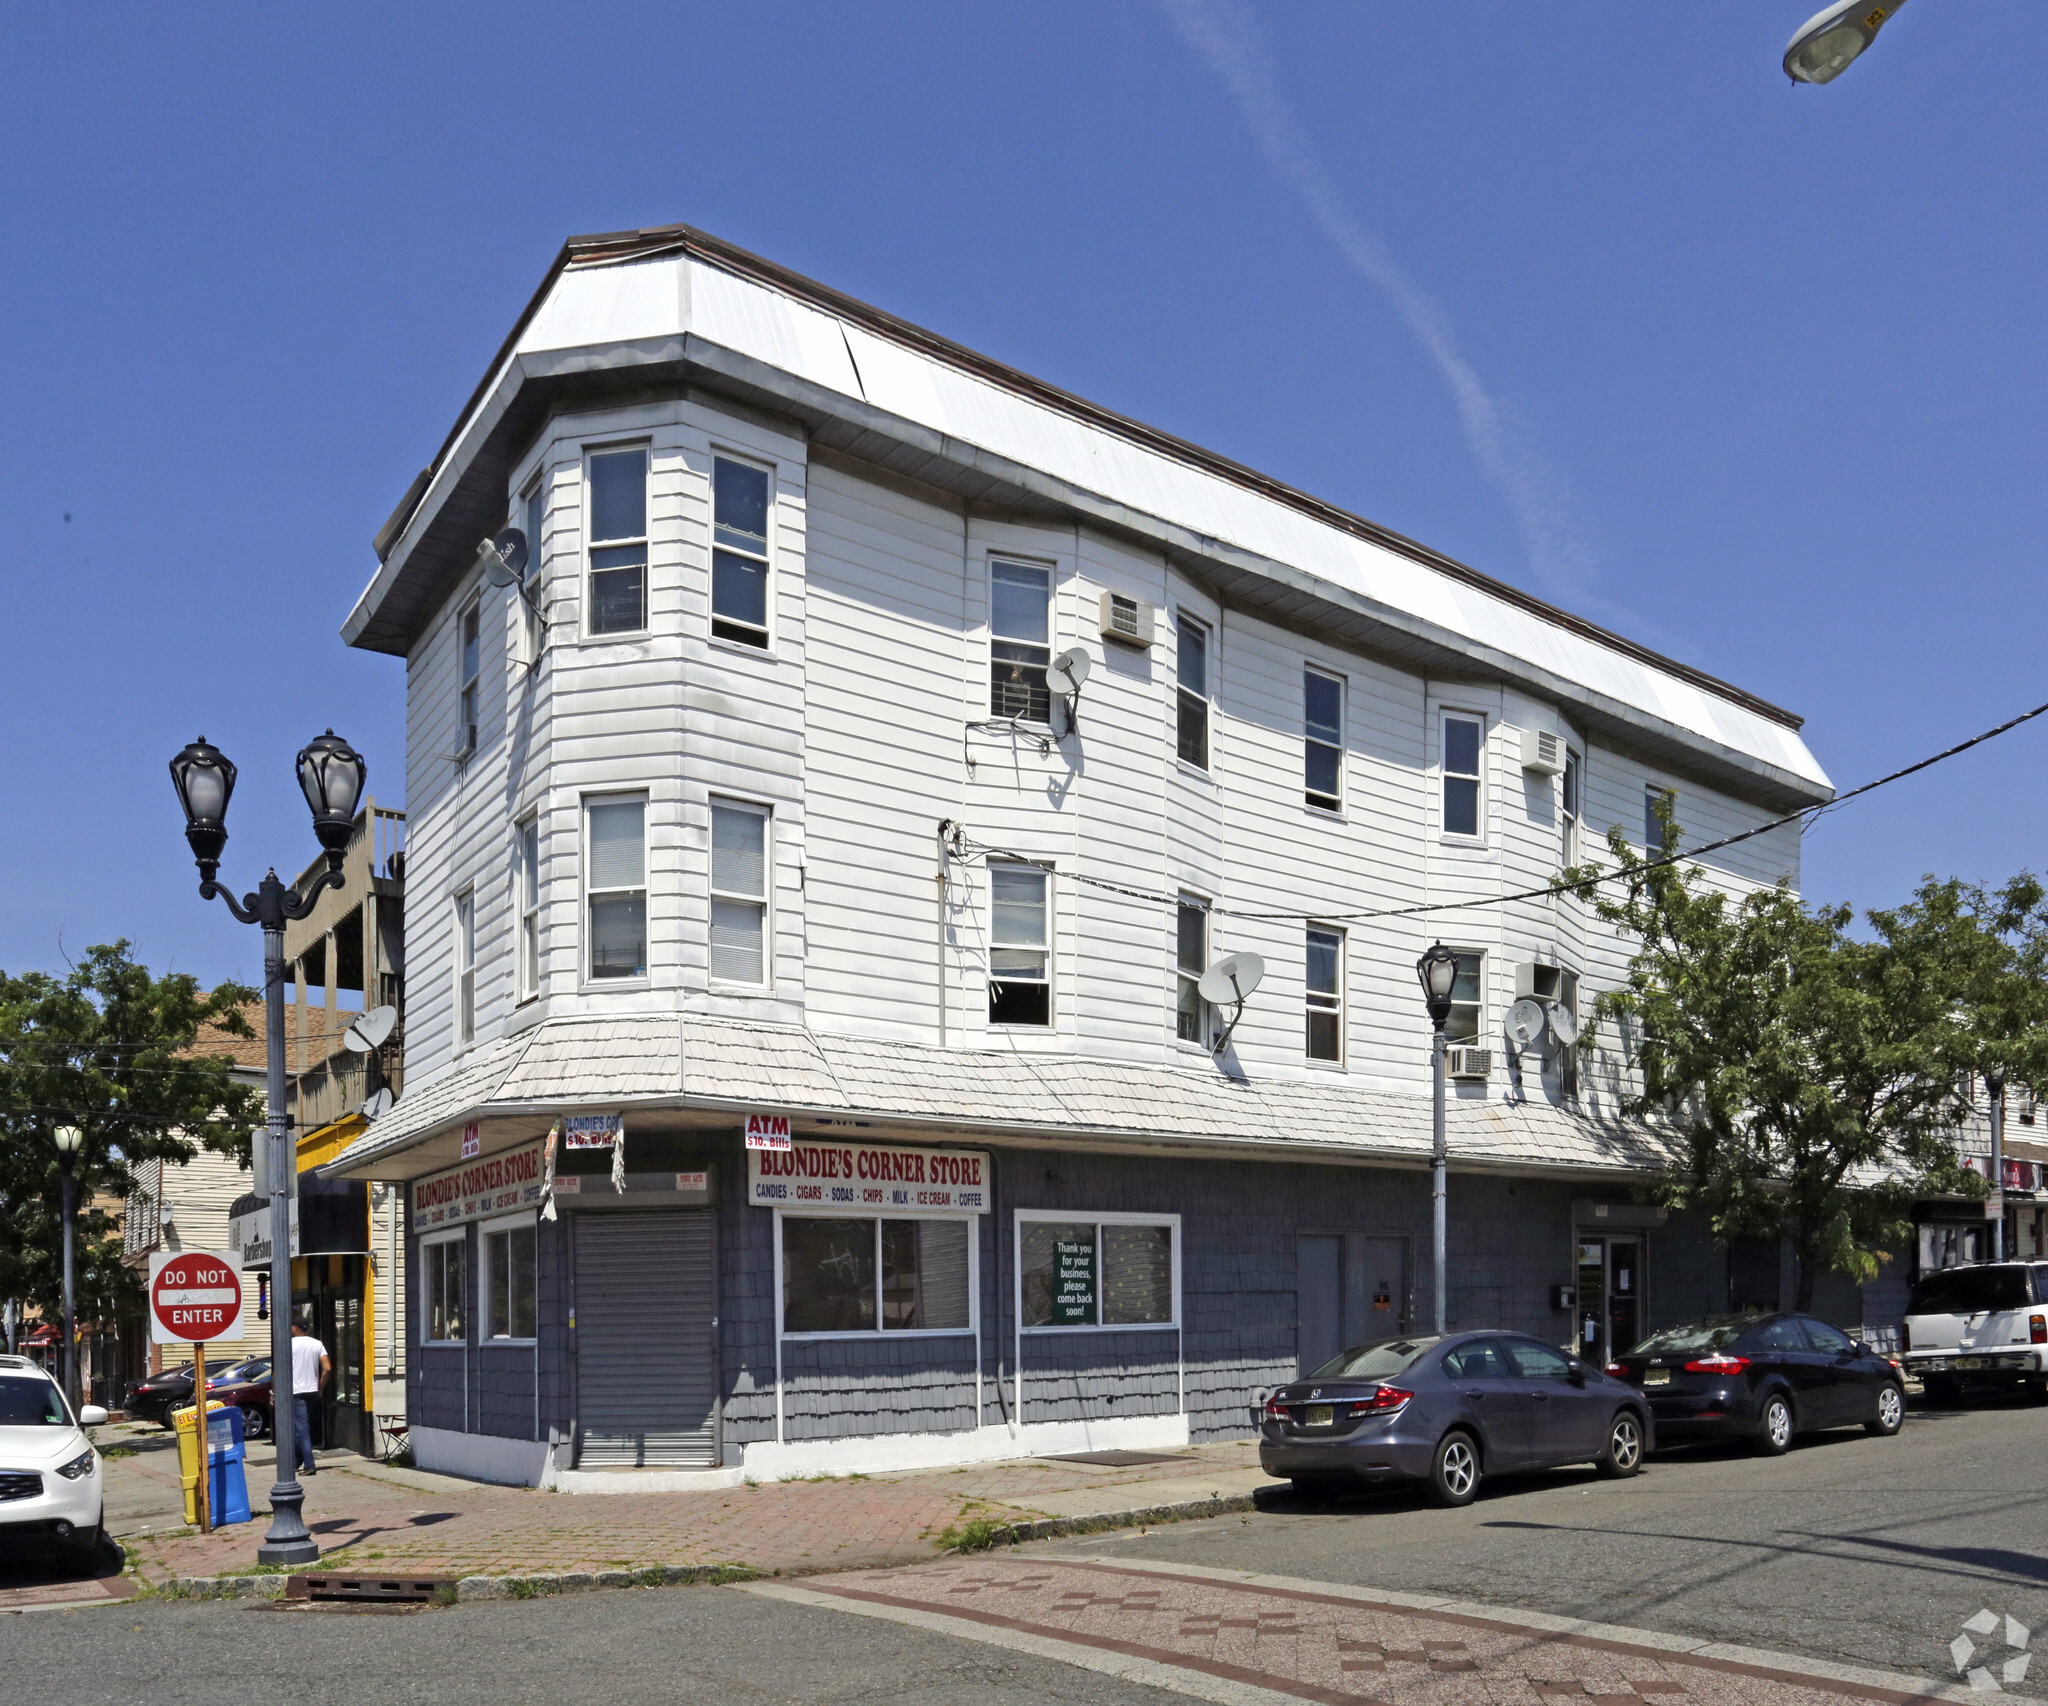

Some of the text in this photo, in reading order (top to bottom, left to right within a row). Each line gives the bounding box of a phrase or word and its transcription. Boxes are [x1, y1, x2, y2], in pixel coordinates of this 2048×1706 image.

[748, 1115, 788, 1135] ATM
[464, 1121, 479, 1144] ATM
[748, 1136, 790, 1148] $10. Bills
[760, 1147, 982, 1186] BLONDIE'S CORNER STORE
[416, 1148, 538, 1210] BLONDIE'S CORNER STORE
[481, 1198, 492, 1212] MILK
[496, 1195, 504, 1208] ICE
[504, 1191, 518, 1206] CREAM
[524, 1186, 540, 1202] COFFEE
[756, 1183, 982, 1206] CANDIES CIGARS SODAS CHIPS MILK ICE CREAM COFFEE
[244, 1239, 272, 1262] Barbershop
[1058, 1242, 1092, 1255] Thank you
[1062, 1255, 1090, 1268] for your
[165, 1270, 227, 1284] DO NOT
[1060, 1268, 1091, 1280] business,
[1064, 1280, 1086, 1293] please
[1058, 1292, 1092, 1304] come back
[172, 1309, 222, 1324] ENTER
[1066, 1306, 1084, 1316] soon!
[178, 1416, 185, 1424] El
